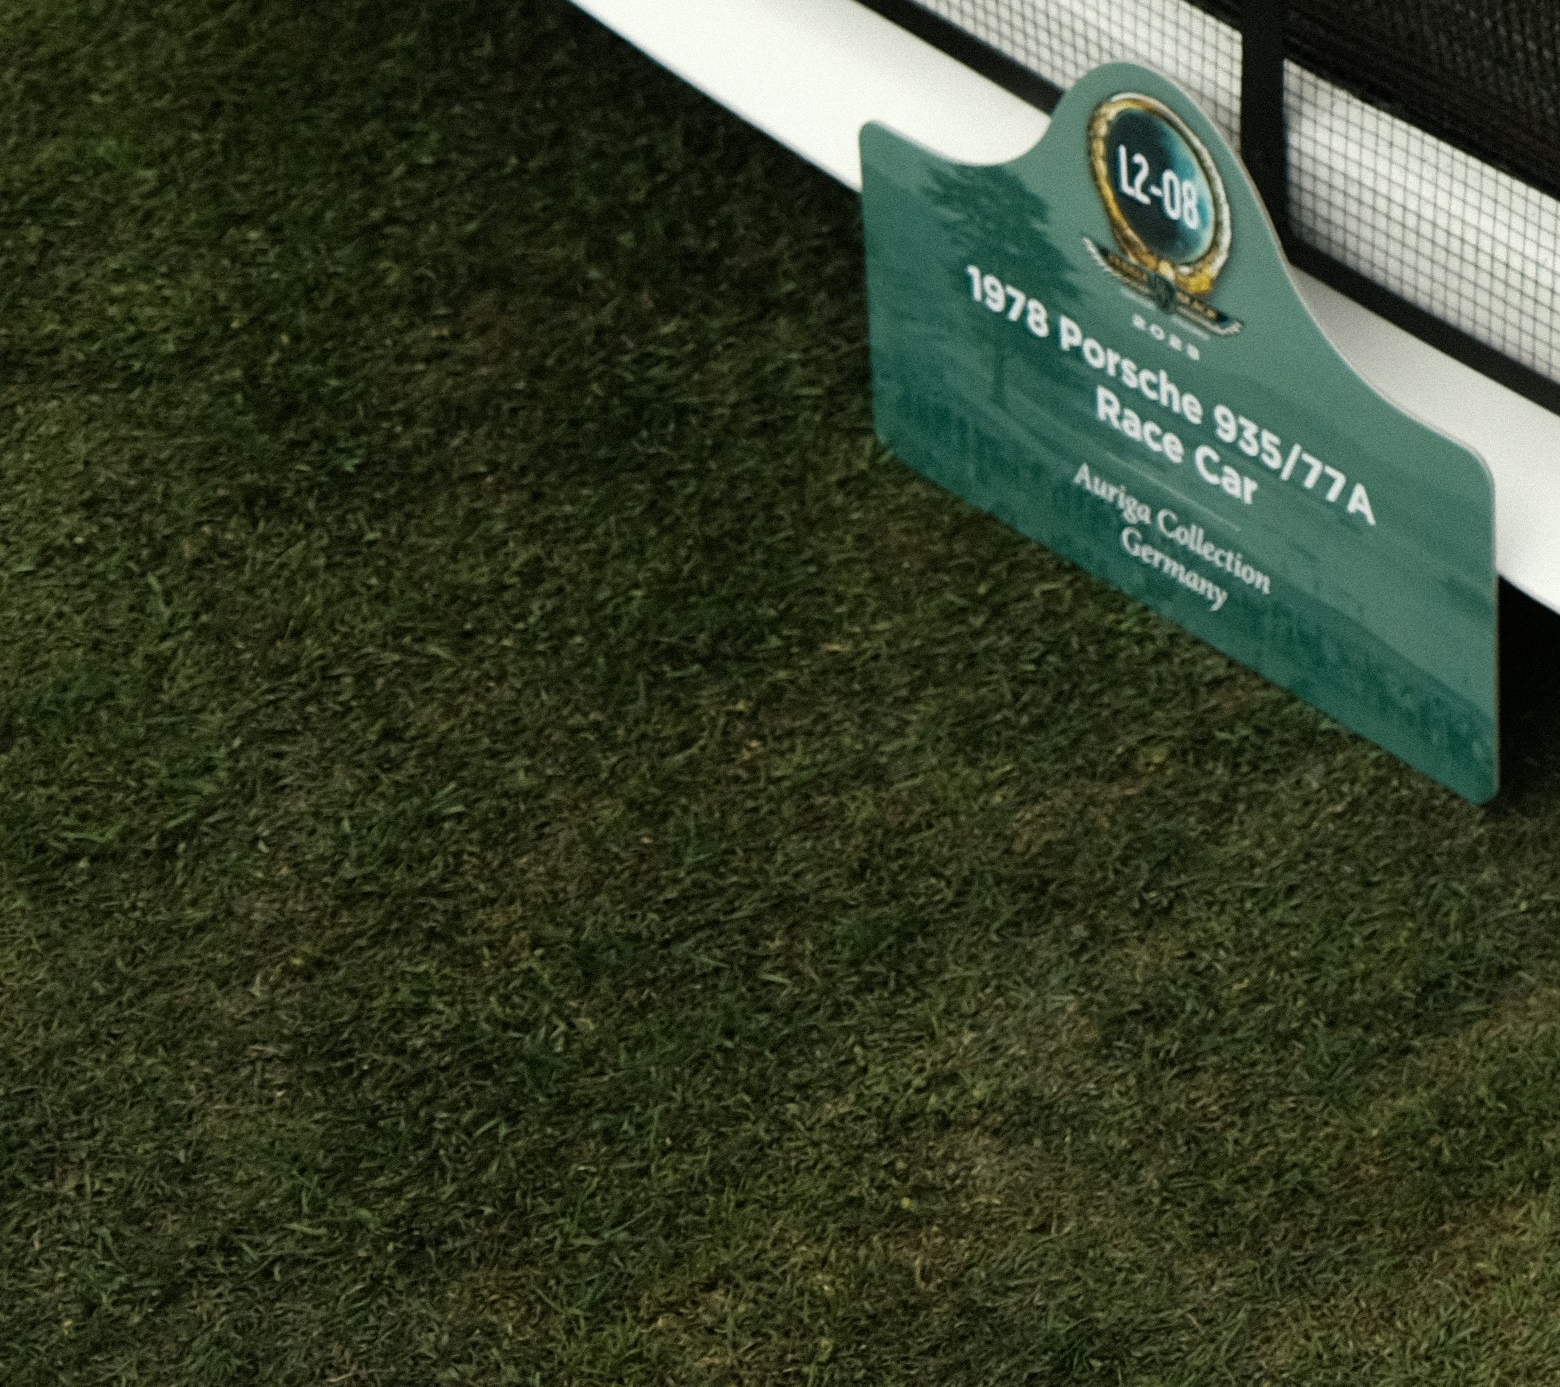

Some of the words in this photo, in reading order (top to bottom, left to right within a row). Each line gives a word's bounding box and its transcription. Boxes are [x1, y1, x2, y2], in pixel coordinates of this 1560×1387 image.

[1118, 144, 1200, 230] L2-08
[966, 264, 1049, 339] 1978
[1059, 318, 1204, 425] Porsche
[1214, 404, 1377, 526] 935/77A
[1097, 385, 1184, 465] Race
[1195, 444, 1259, 506] Car
[1073, 463, 1152, 525] Auriga
[1157, 507, 1272, 596] Collection
[1120, 528, 1229, 613] Germany
